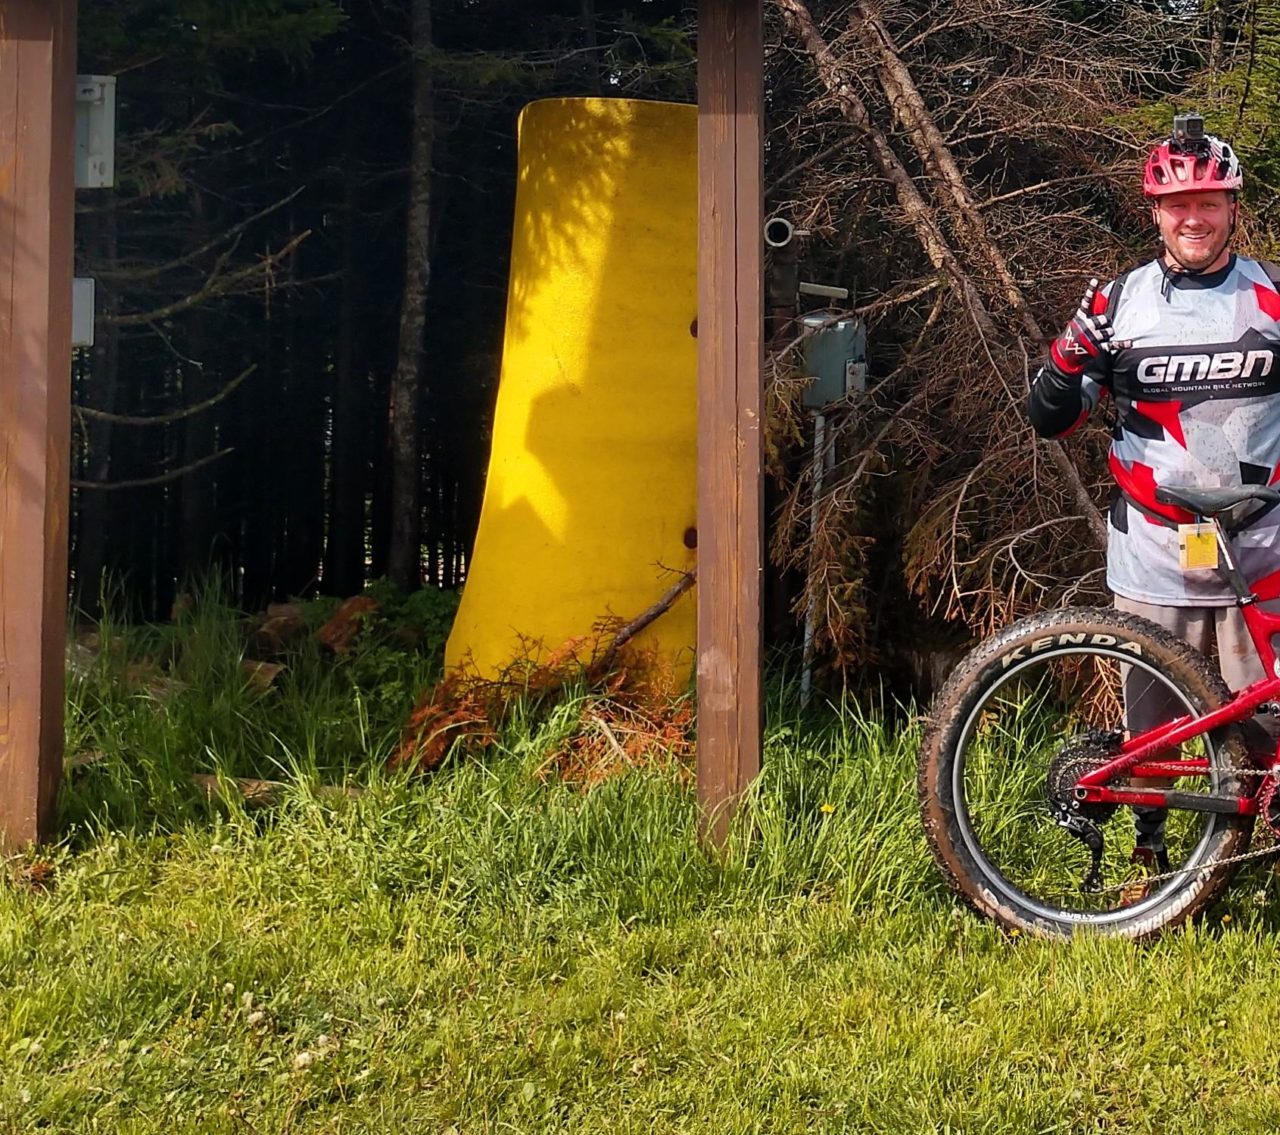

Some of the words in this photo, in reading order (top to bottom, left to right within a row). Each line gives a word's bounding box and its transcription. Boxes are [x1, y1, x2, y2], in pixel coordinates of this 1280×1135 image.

[1137, 350, 1275, 384] GMBN
[1213, 383, 1231, 391] BIKE
[1232, 381, 1266, 390] NETWORK
[1002, 633, 1143, 669] KENDA
